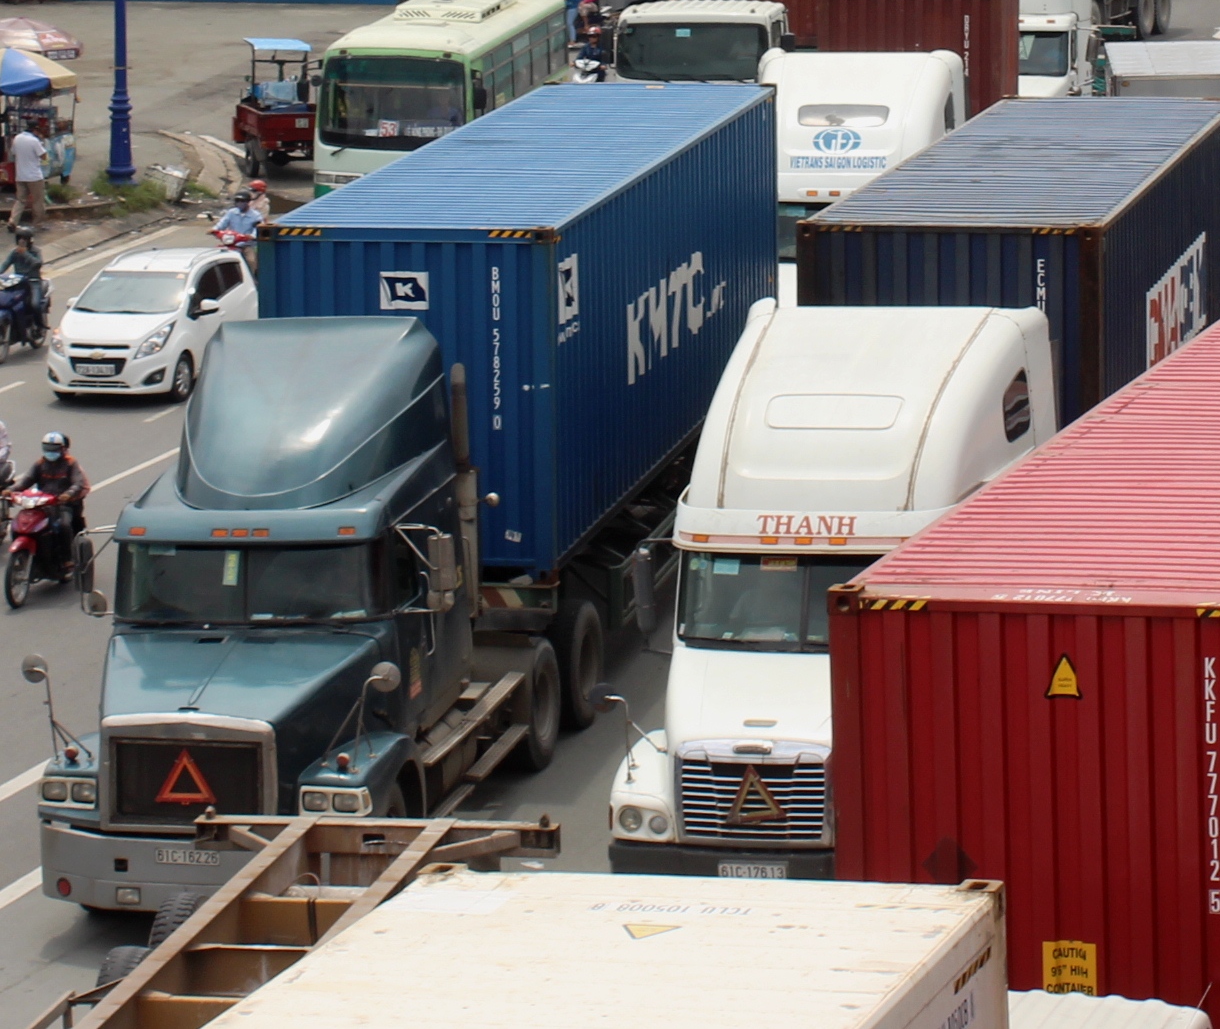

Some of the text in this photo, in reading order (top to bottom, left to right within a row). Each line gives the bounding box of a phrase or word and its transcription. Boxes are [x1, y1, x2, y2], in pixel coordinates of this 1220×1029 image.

[380, 122, 398, 138] 53
[790, 156, 824, 169] VIETRANS
[852, 156, 887, 169] LOGISTIC
[395, 281, 415, 299] K
[490, 266, 501, 321] BMOU
[1036, 258, 1047, 312] ECMU
[492, 328, 501, 410] 578259
[756, 514, 858, 536] THANH
[1204, 656, 1218, 745] KKFU
[1206, 750, 1220, 882] 777012
